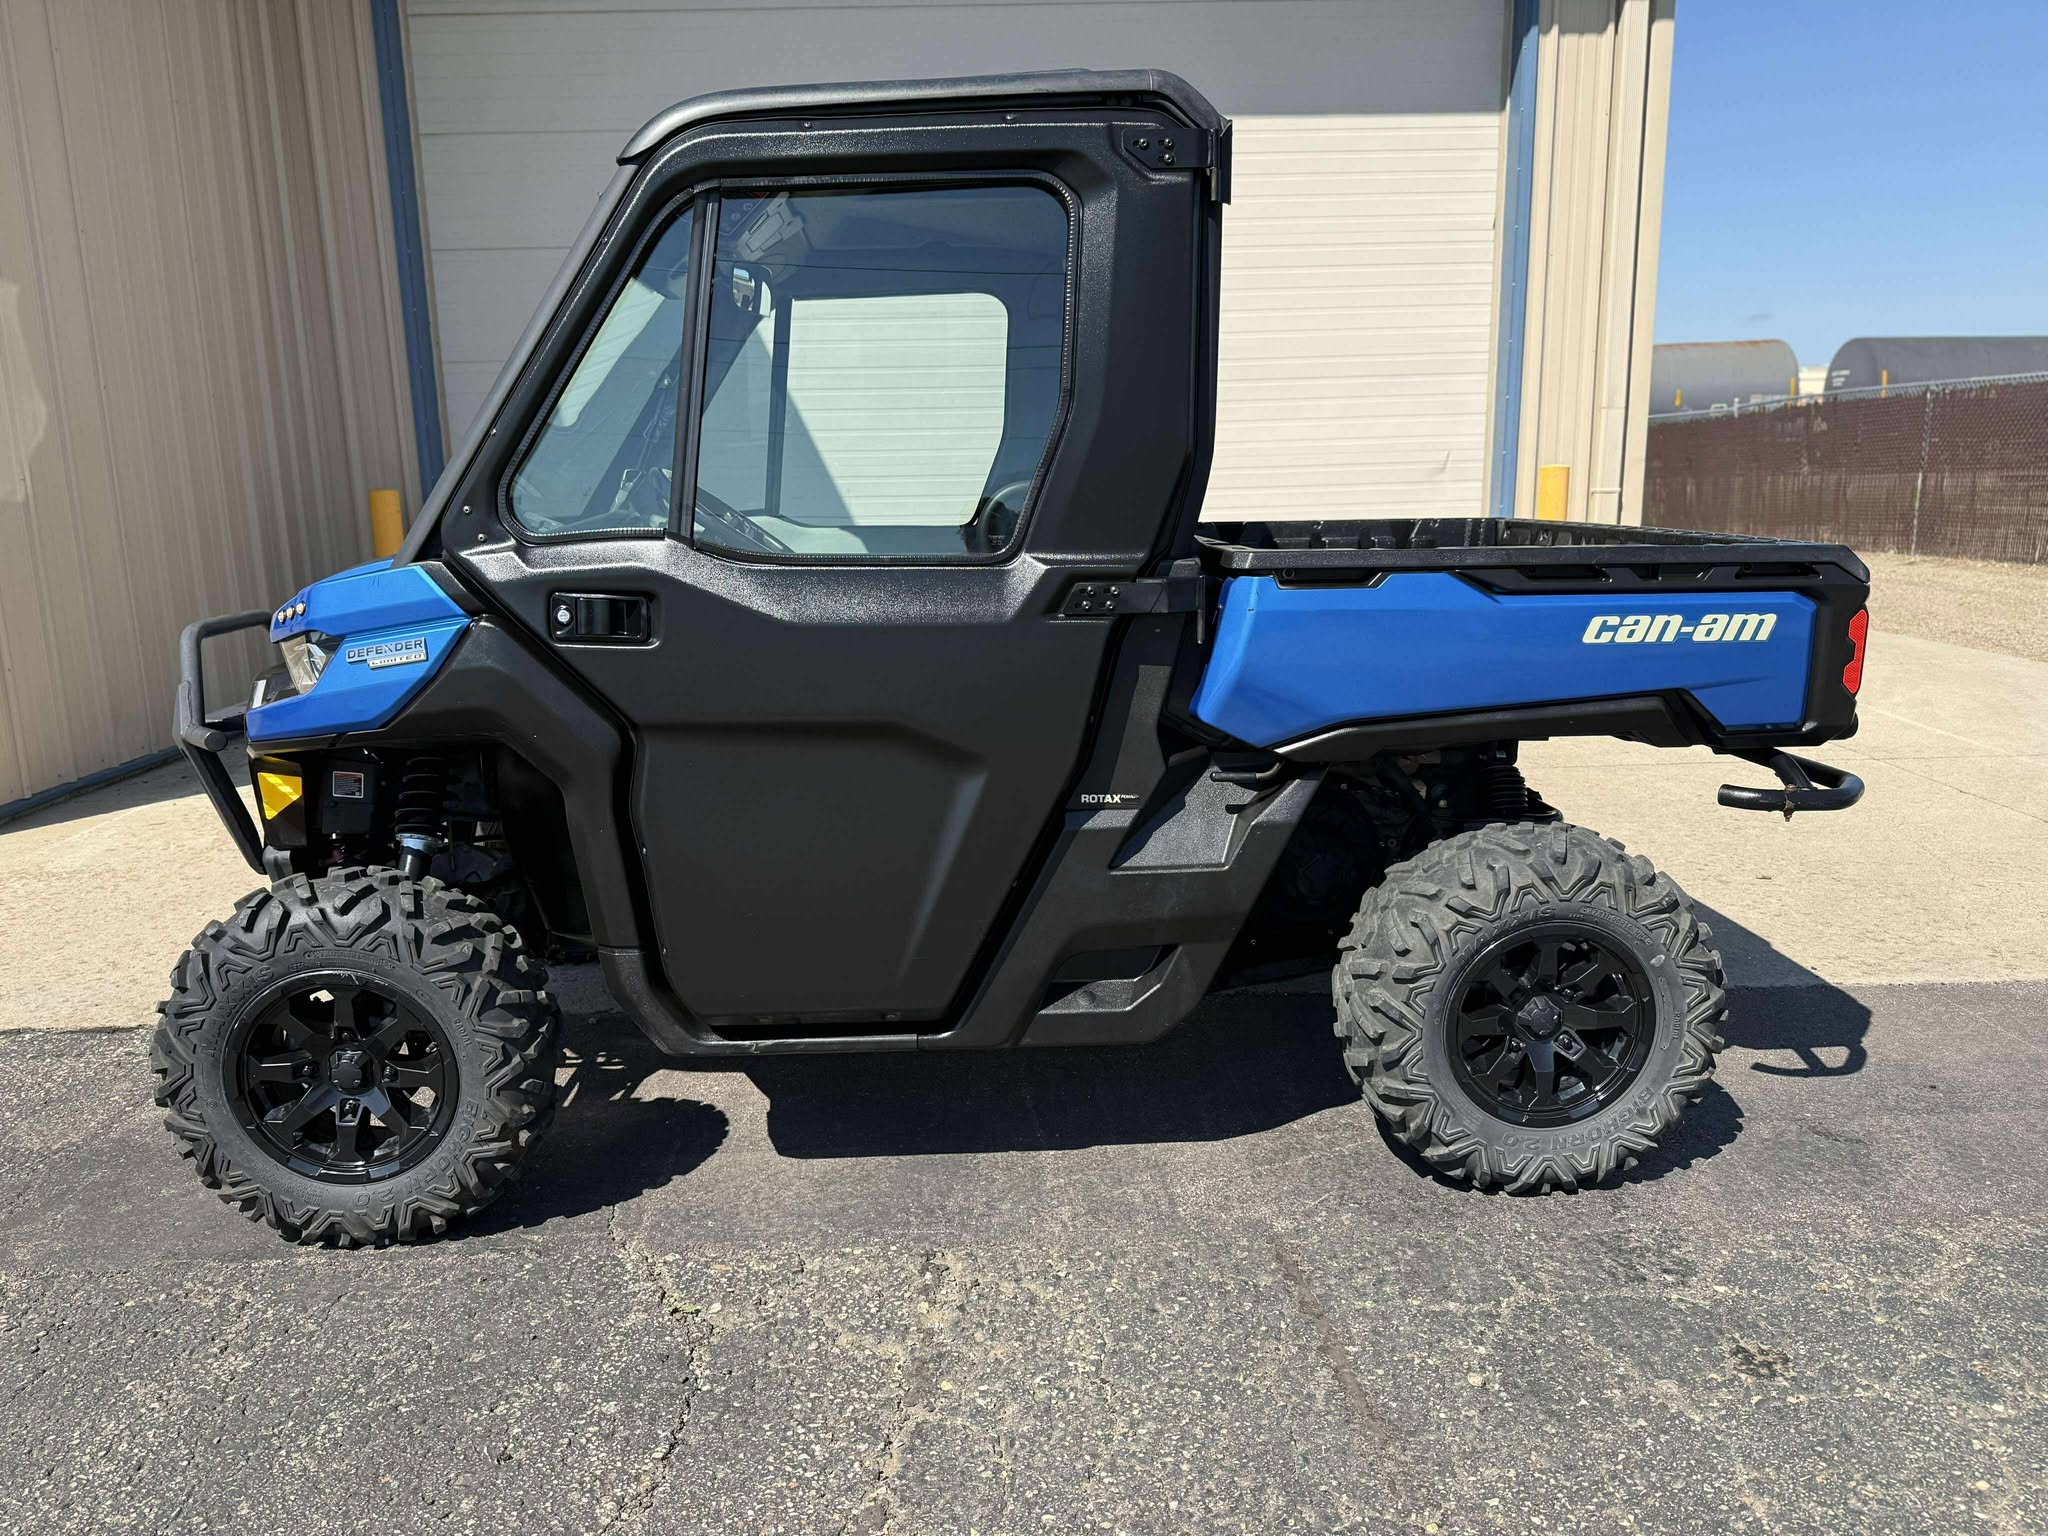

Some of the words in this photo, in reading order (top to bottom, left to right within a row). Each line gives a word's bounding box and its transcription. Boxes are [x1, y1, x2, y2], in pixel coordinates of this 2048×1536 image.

[1582, 613, 1777, 643] can-am
[347, 639, 423, 659] DEFENDER
[1081, 794, 1121, 803] ROTAX
